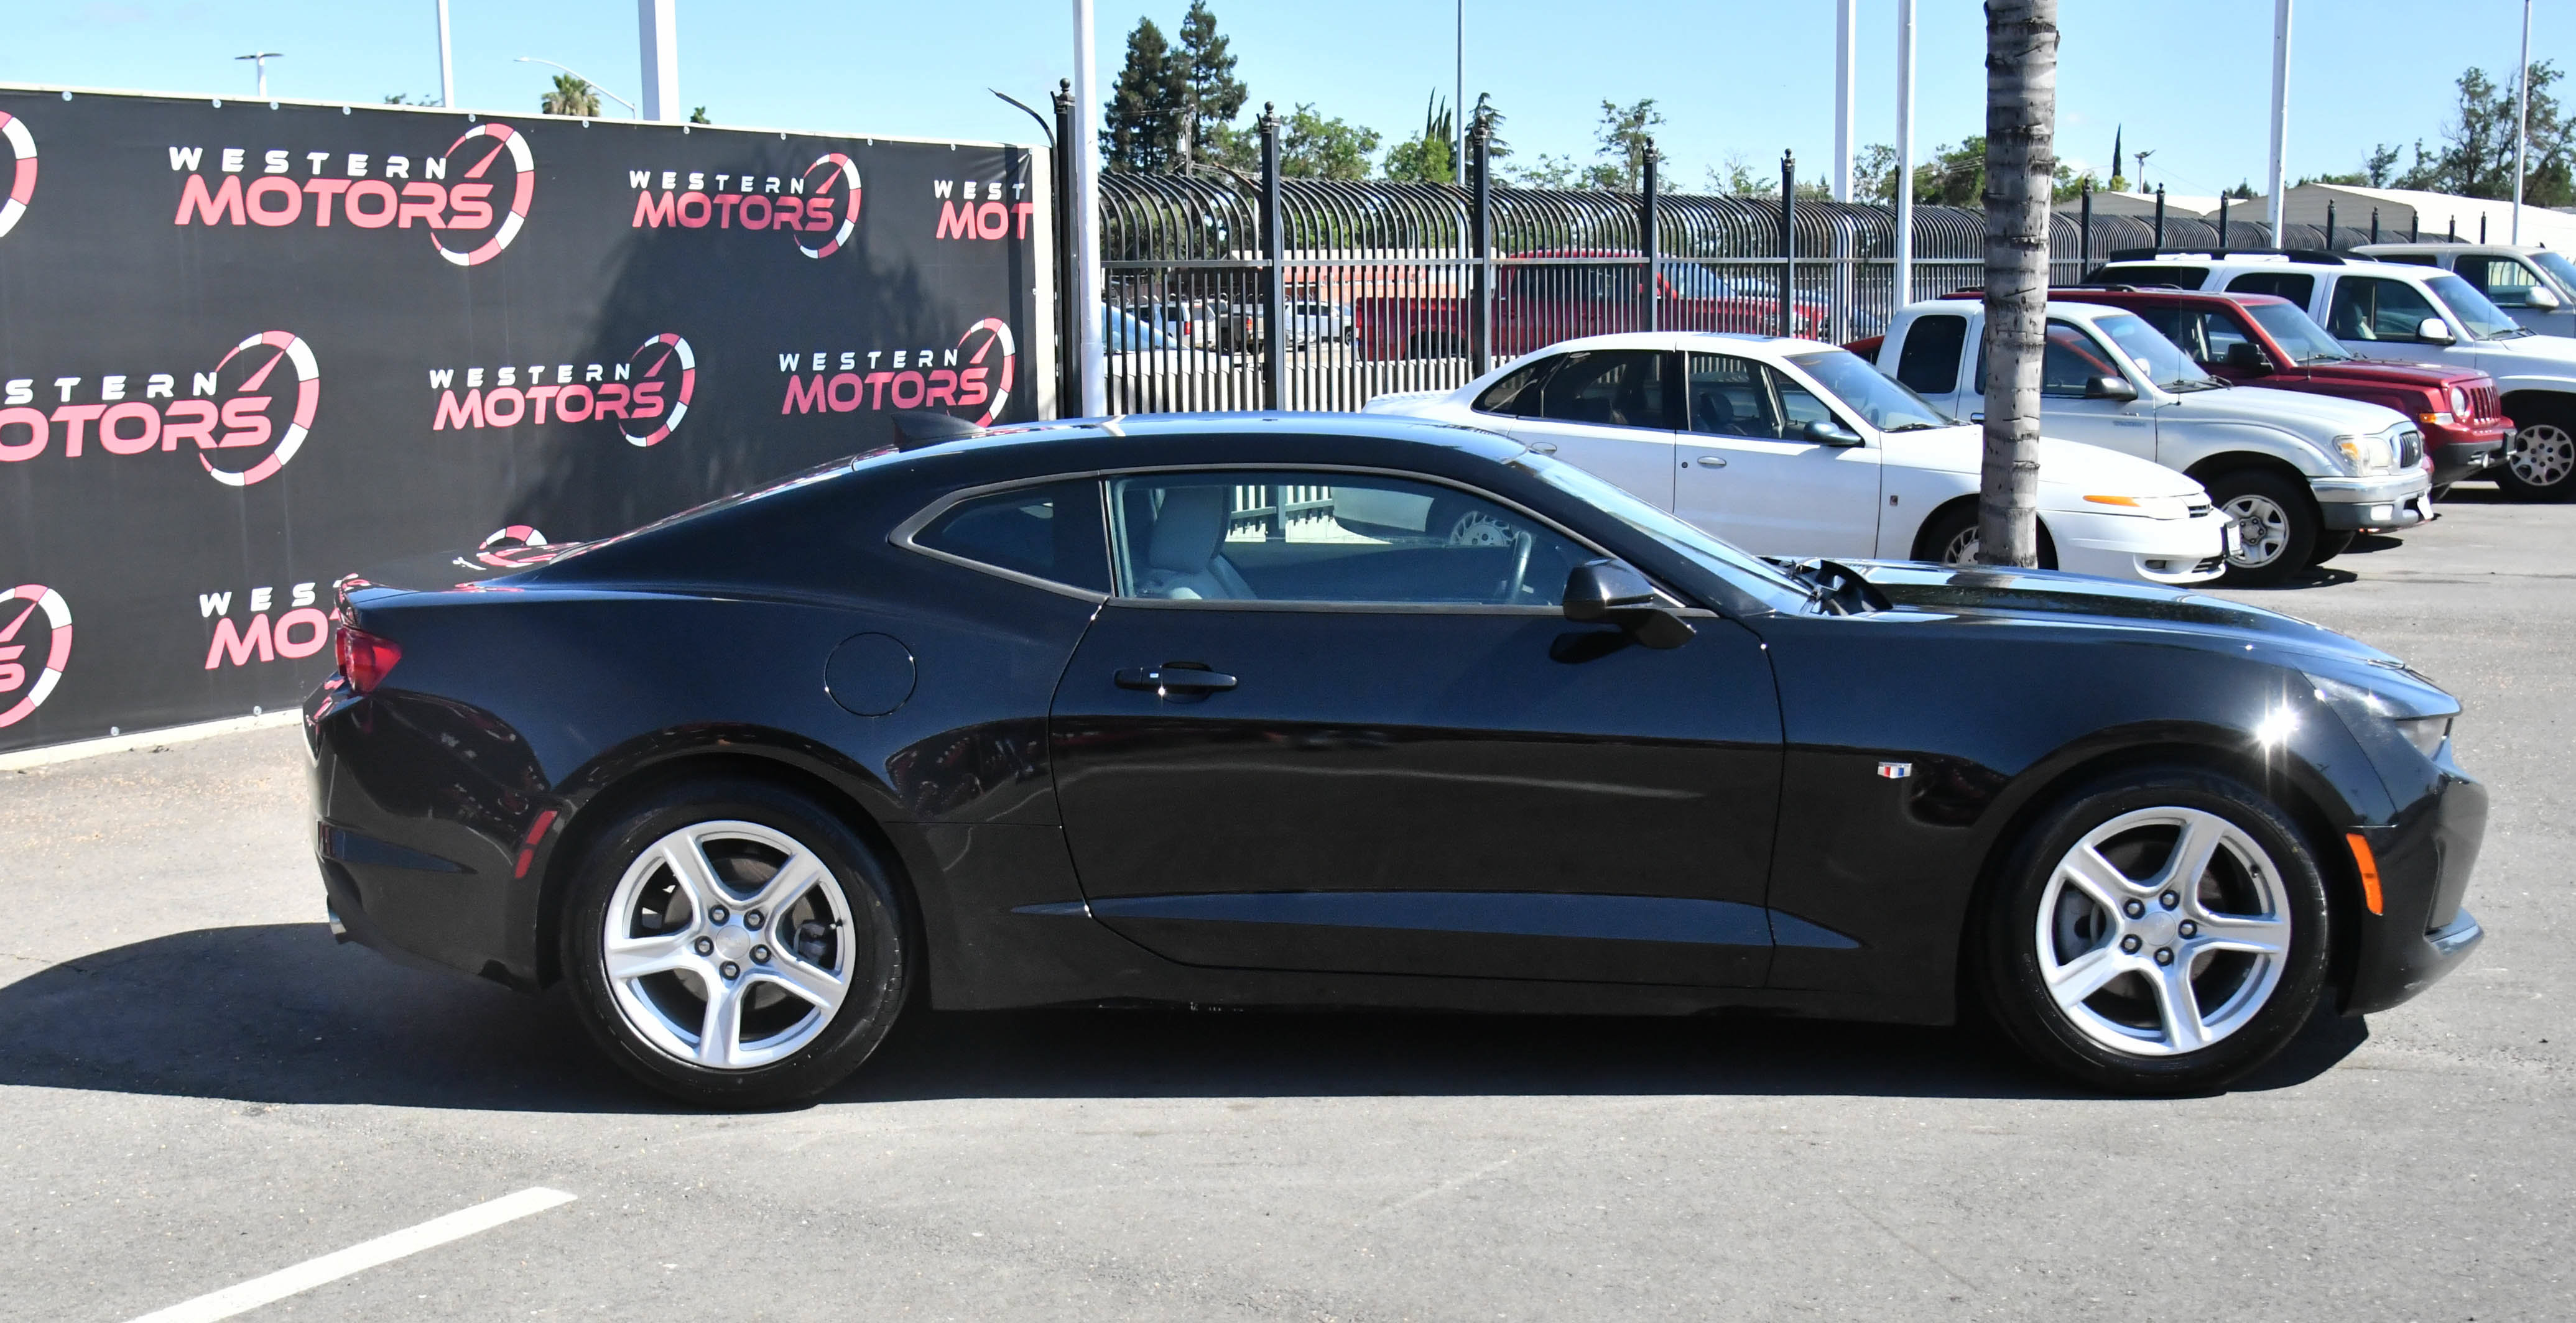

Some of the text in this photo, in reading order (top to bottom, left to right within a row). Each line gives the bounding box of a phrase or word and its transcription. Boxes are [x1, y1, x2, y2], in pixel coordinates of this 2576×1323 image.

[169, 147, 447, 179] WESTERN
[629, 170, 804, 195] WESTERN
[174, 174, 494, 230] MOTORS
[934, 180, 1025, 200] WEST
[632, 190, 835, 233] MOTORS
[936, 200, 1034, 240] MOT
[430, 362, 631, 389] WESTERN
[779, 349, 958, 372] WESTERN
[4, 372, 218, 405] STERN
[433, 380, 665, 431] MOTORS
[781, 367, 989, 415] MOTORS
[199, 579, 343, 618] WES
[205, 607, 341, 670] MO
